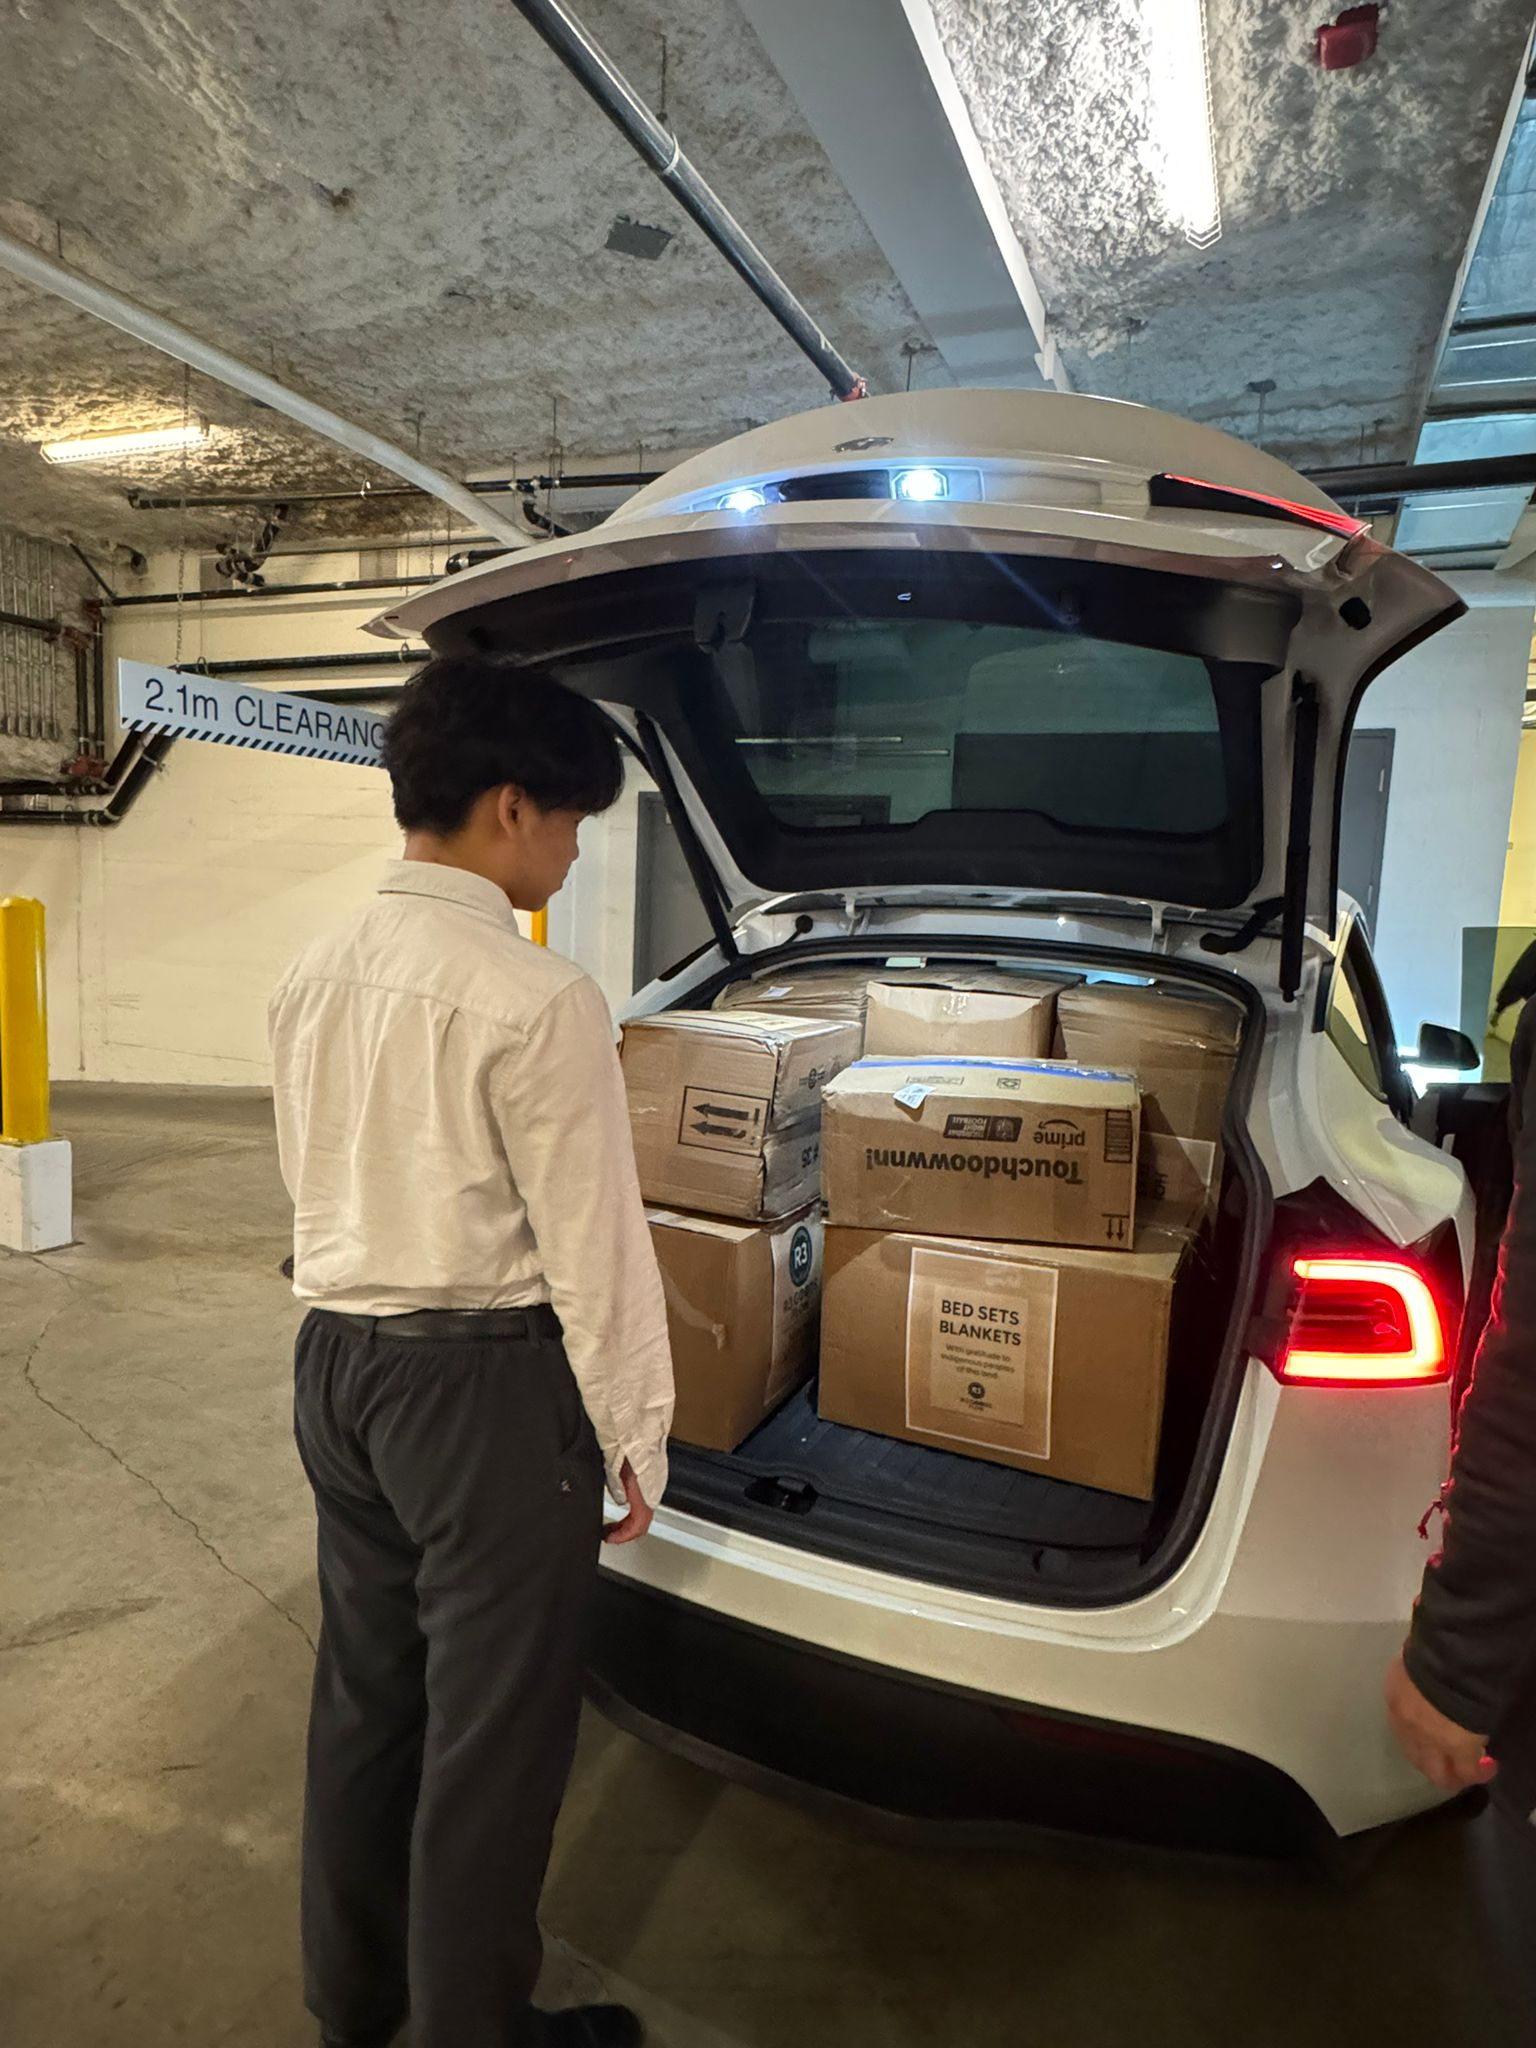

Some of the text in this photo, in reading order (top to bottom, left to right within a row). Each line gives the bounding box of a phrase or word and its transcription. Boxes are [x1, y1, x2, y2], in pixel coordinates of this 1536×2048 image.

[145, 678, 385, 750] 2.1m CLEARANC
[1032, 1129, 1086, 1149] prime
[865, 1148, 1084, 1184] Touchdoowwnn!
[794, 1242, 808, 1270] R3
[941, 1299, 1020, 1326] BED SETS
[939, 1320, 1022, 1346] BLANKETS
